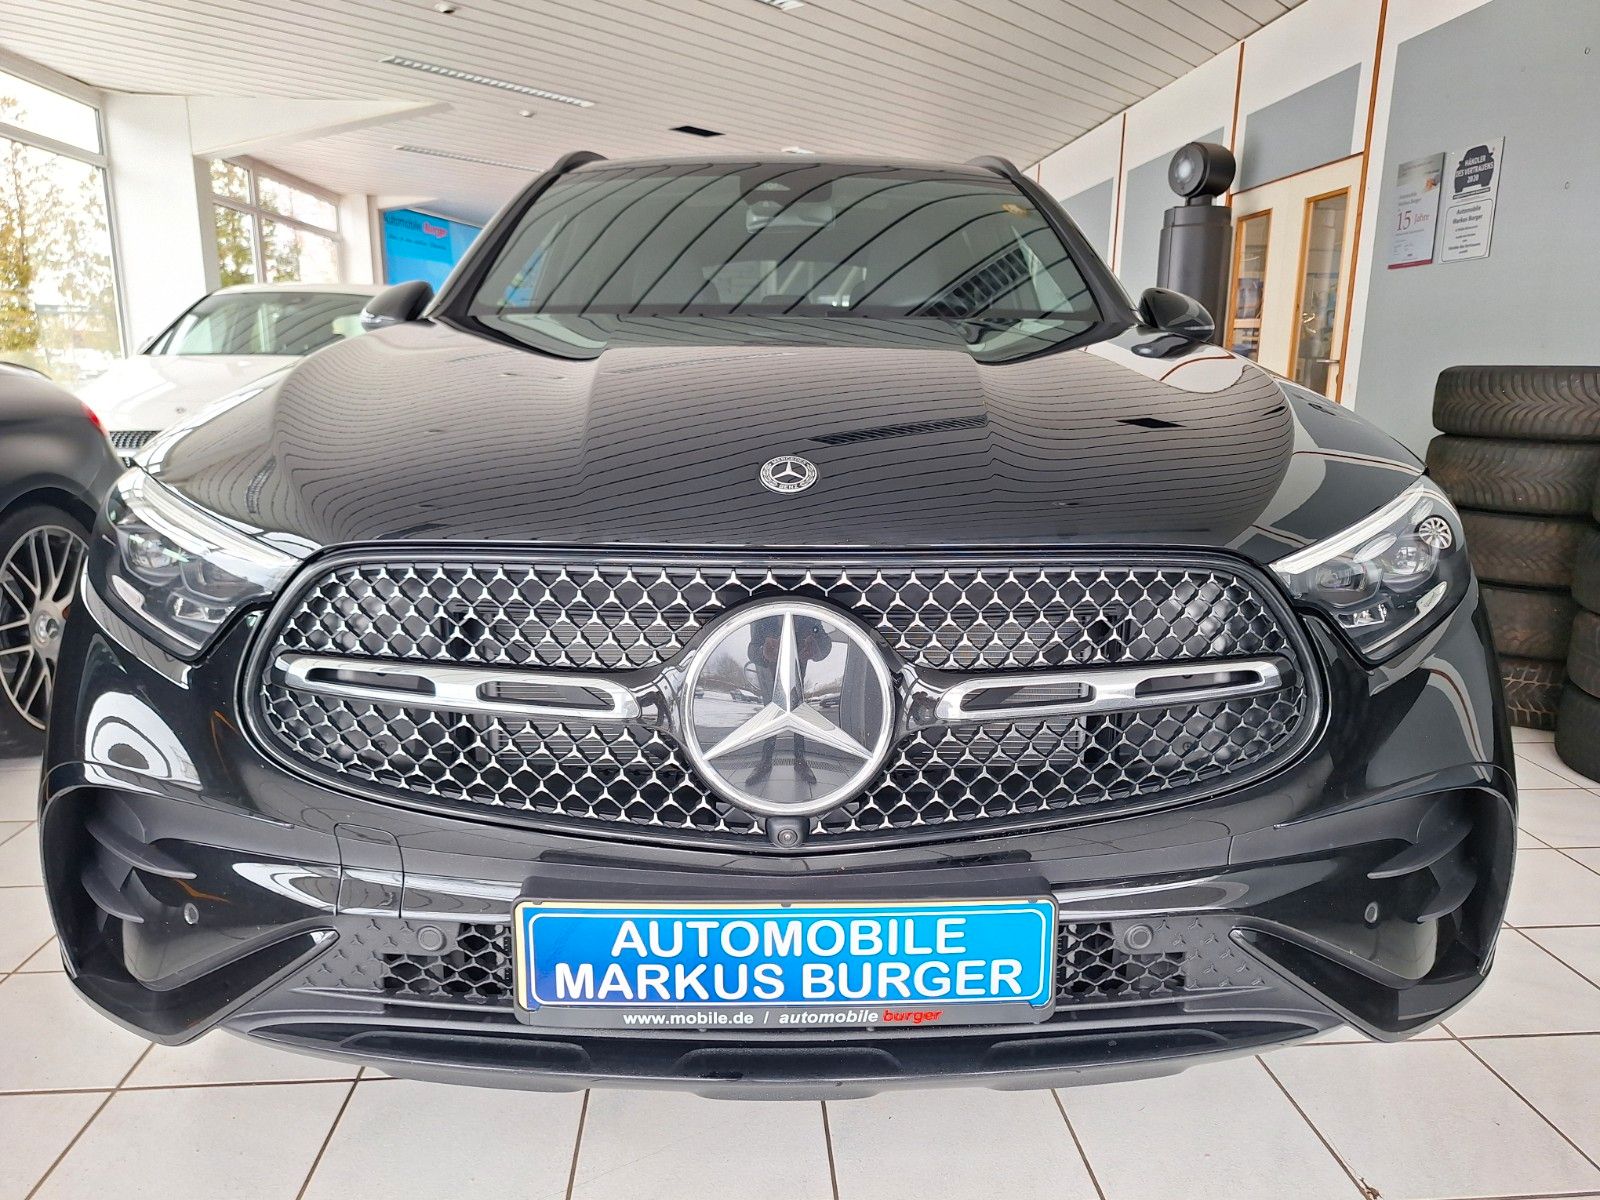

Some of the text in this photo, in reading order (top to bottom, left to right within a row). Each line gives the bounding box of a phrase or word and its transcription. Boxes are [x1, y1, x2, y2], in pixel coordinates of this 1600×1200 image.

[1396, 210, 1411, 231] 15
[610, 917, 967, 958] AUTOMOBILE
[554, 958, 1023, 1001] MARKUS BURGER
[622, 1008, 944, 1025] www.mobile.de / automobile burger
